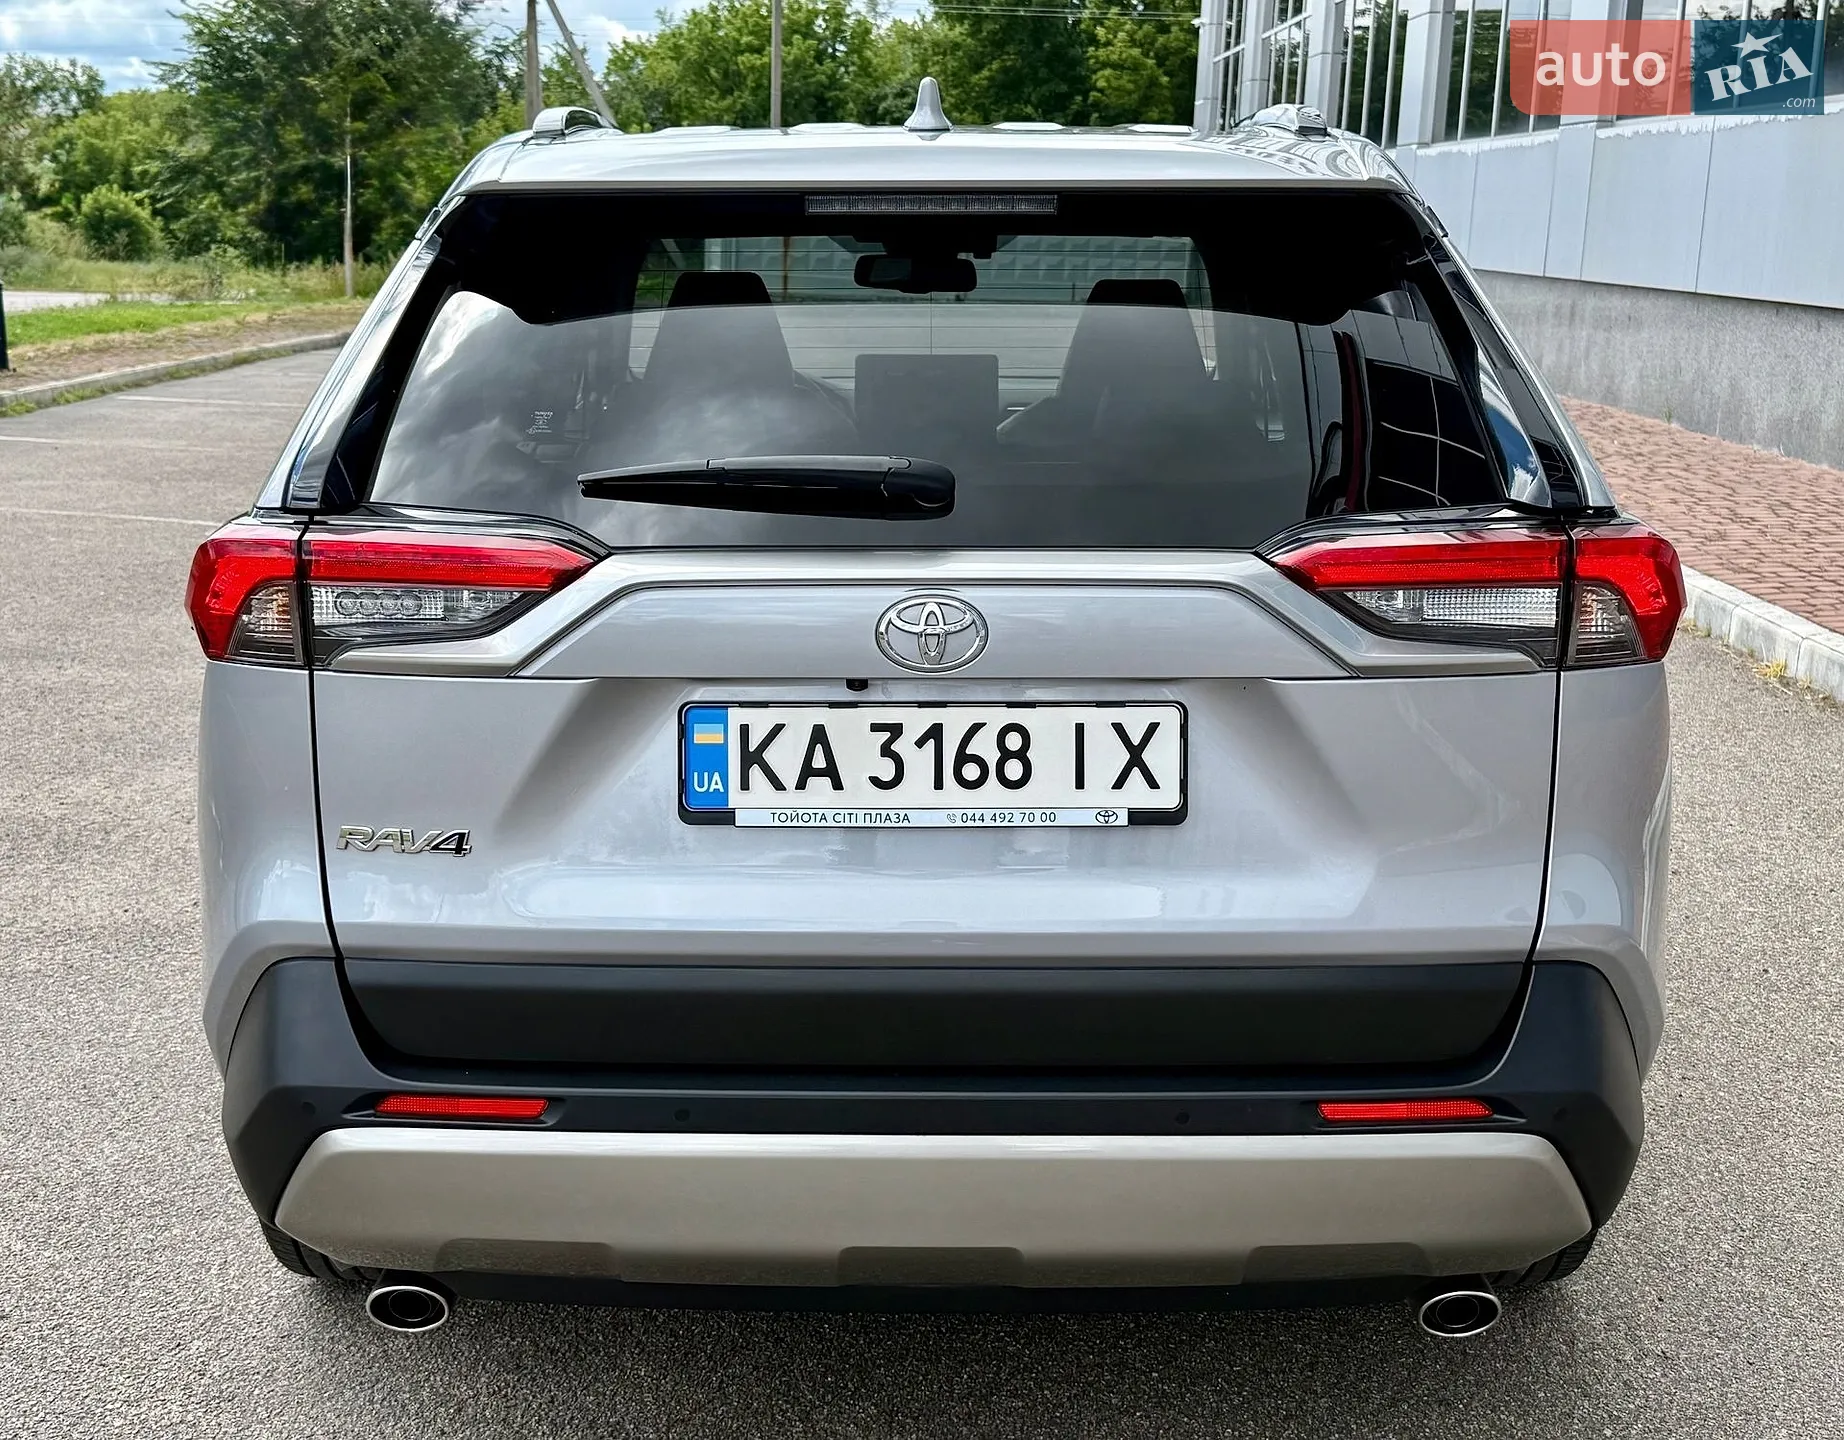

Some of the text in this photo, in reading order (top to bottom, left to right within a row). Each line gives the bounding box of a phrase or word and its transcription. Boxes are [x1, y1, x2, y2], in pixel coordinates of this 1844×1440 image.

[739, 722, 1161, 791] KA 3168 IX
[693, 771, 725, 793] UA
[770, 810, 911, 824] ТОЙОТА СІТІ ПЛАЗА
[961, 812, 1057, 823] 044 492 70 00
[336, 825, 472, 858] RAV4
